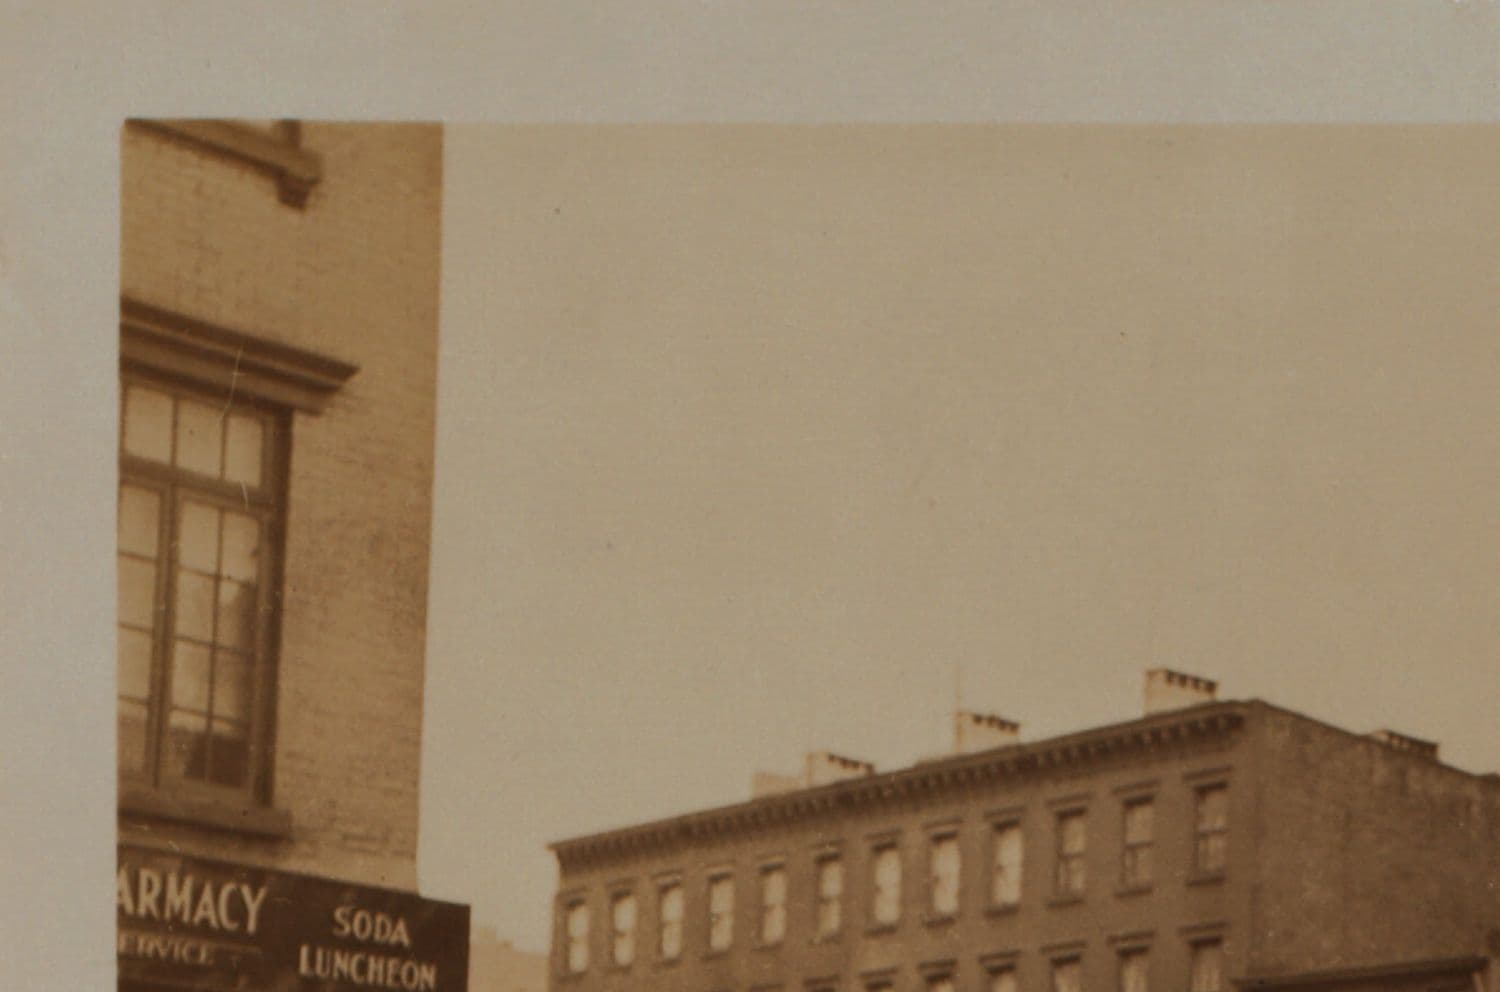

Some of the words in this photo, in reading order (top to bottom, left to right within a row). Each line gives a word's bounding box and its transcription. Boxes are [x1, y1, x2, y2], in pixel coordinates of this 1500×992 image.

[117, 863, 267, 934] ARMACY
[333, 904, 411, 947] SODA
[299, 944, 437, 992] LUNCHEON
